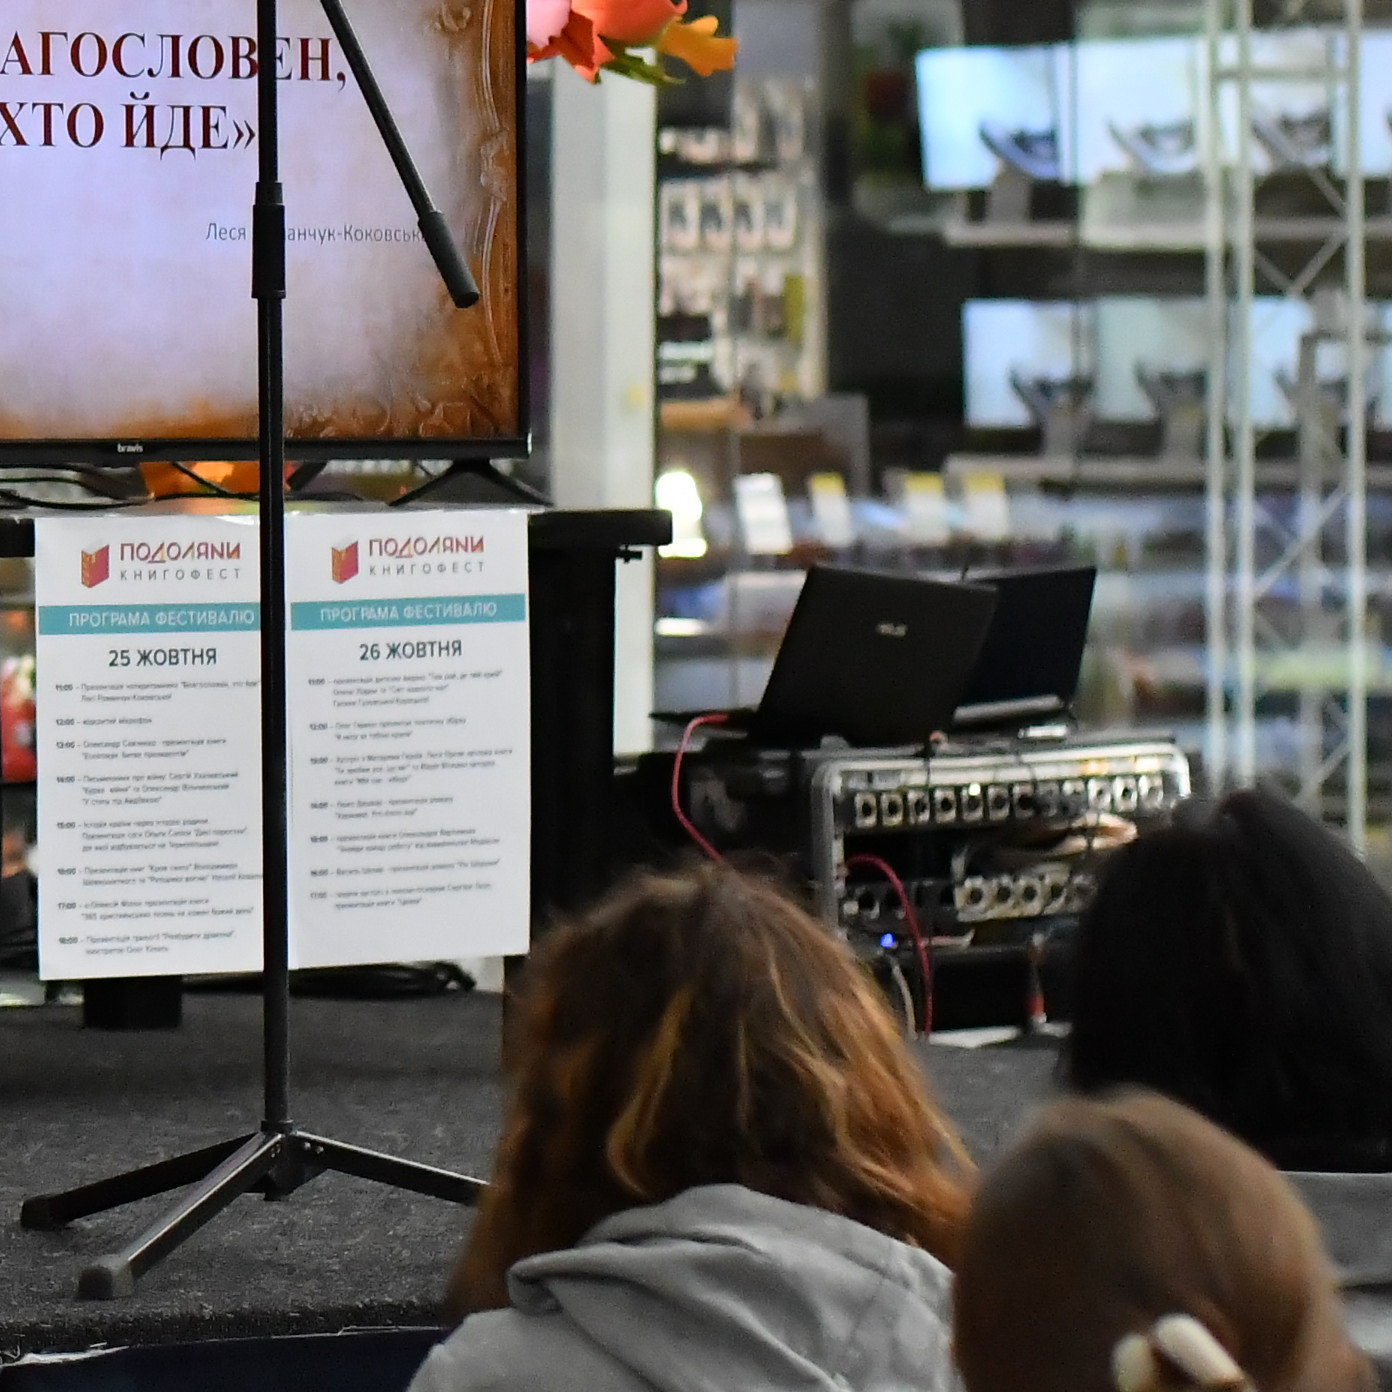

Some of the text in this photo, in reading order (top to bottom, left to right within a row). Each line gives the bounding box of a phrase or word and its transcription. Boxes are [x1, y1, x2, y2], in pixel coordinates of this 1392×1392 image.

[121, 90, 257, 160] ЙДЕ»
[206, 222, 246, 241] Леся
[120, 567, 241, 581] КНИГОФЕСТ
[369, 561, 485, 576] КНИГОФЕСТ
[69, 608, 255, 628] ПРОГРАМА ФЕСТИВАЛЮ
[320, 601, 497, 622] ПРОГРАМА ФЕСТИВАЛЮ
[108, 648, 217, 667] 25 ЖОВТНЯ
[359, 640, 462, 661] 26 ЖОВТНЯ
